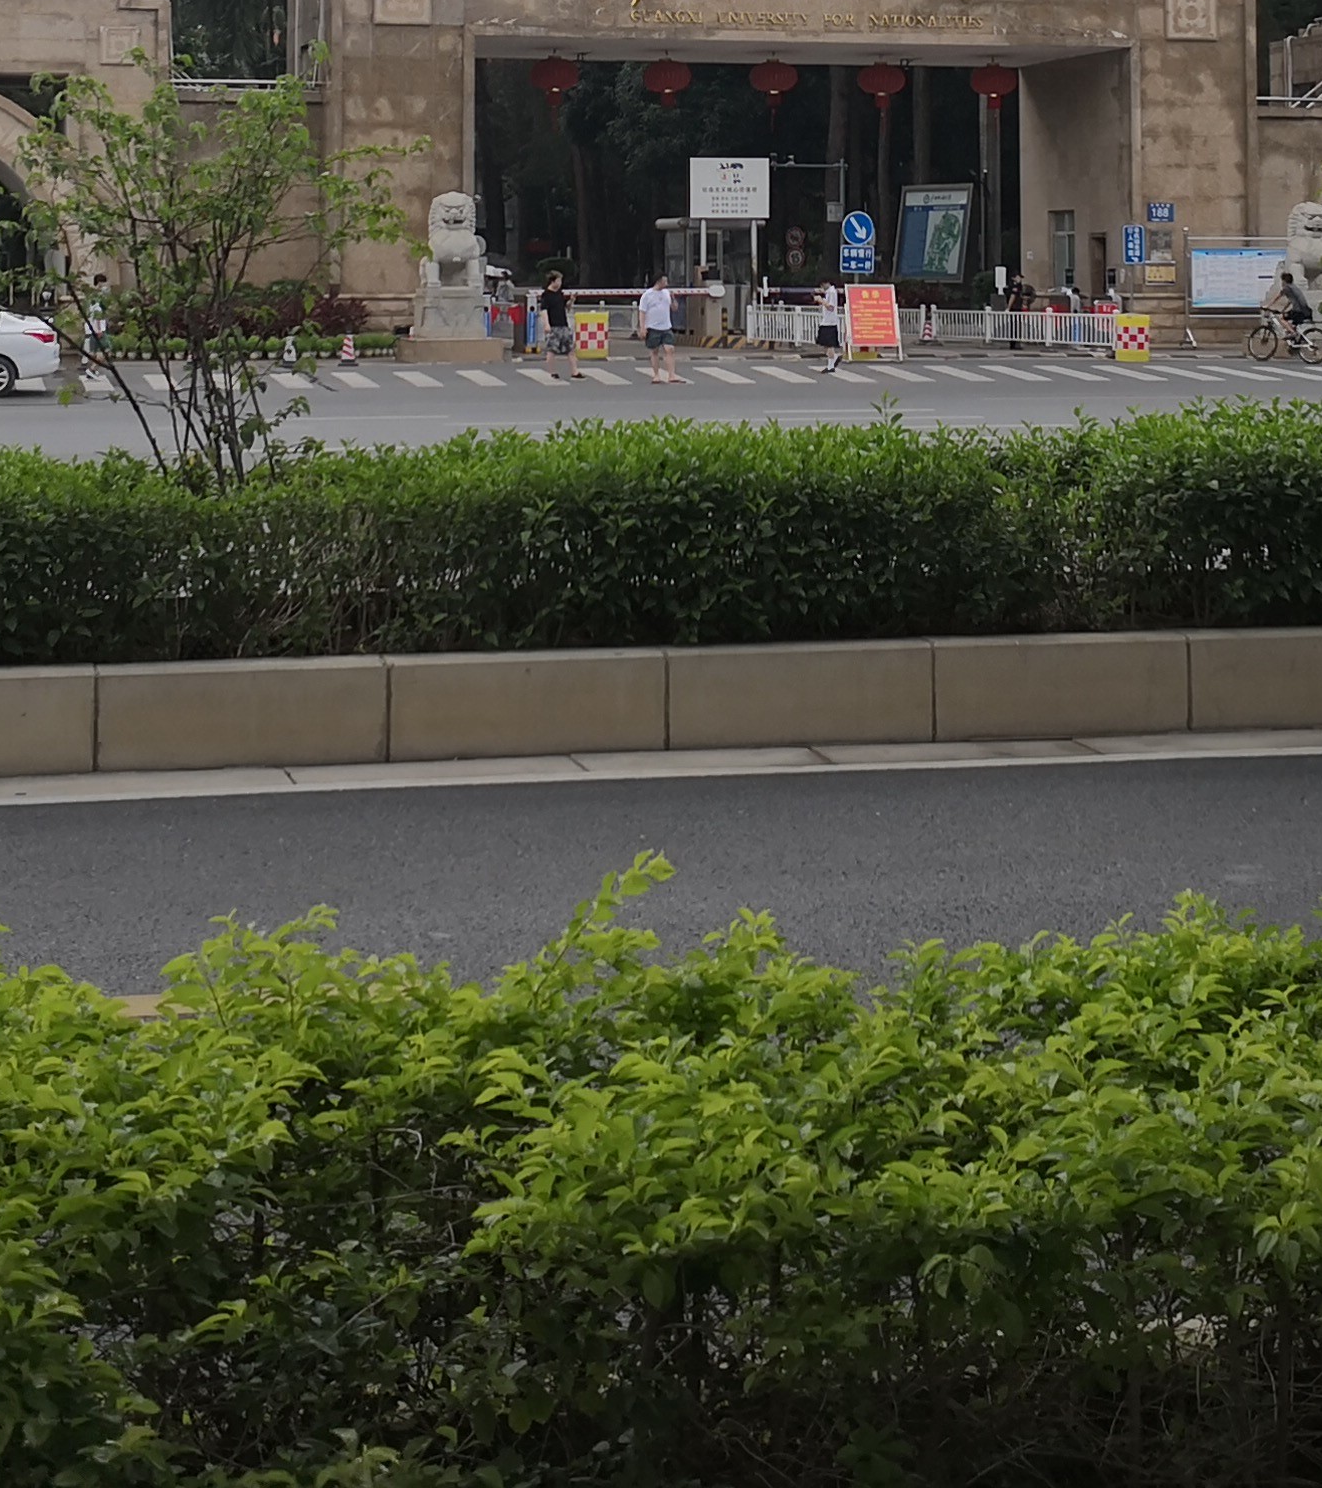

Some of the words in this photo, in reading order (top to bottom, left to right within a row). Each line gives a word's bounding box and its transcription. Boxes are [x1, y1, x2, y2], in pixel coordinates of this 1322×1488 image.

[630, 10, 703, 24] GUANGXI
[716, 11, 809, 26] UNIVERSITY
[823, 13, 855, 27] FOR
[868, 13, 985, 29] NATIONALITIES
